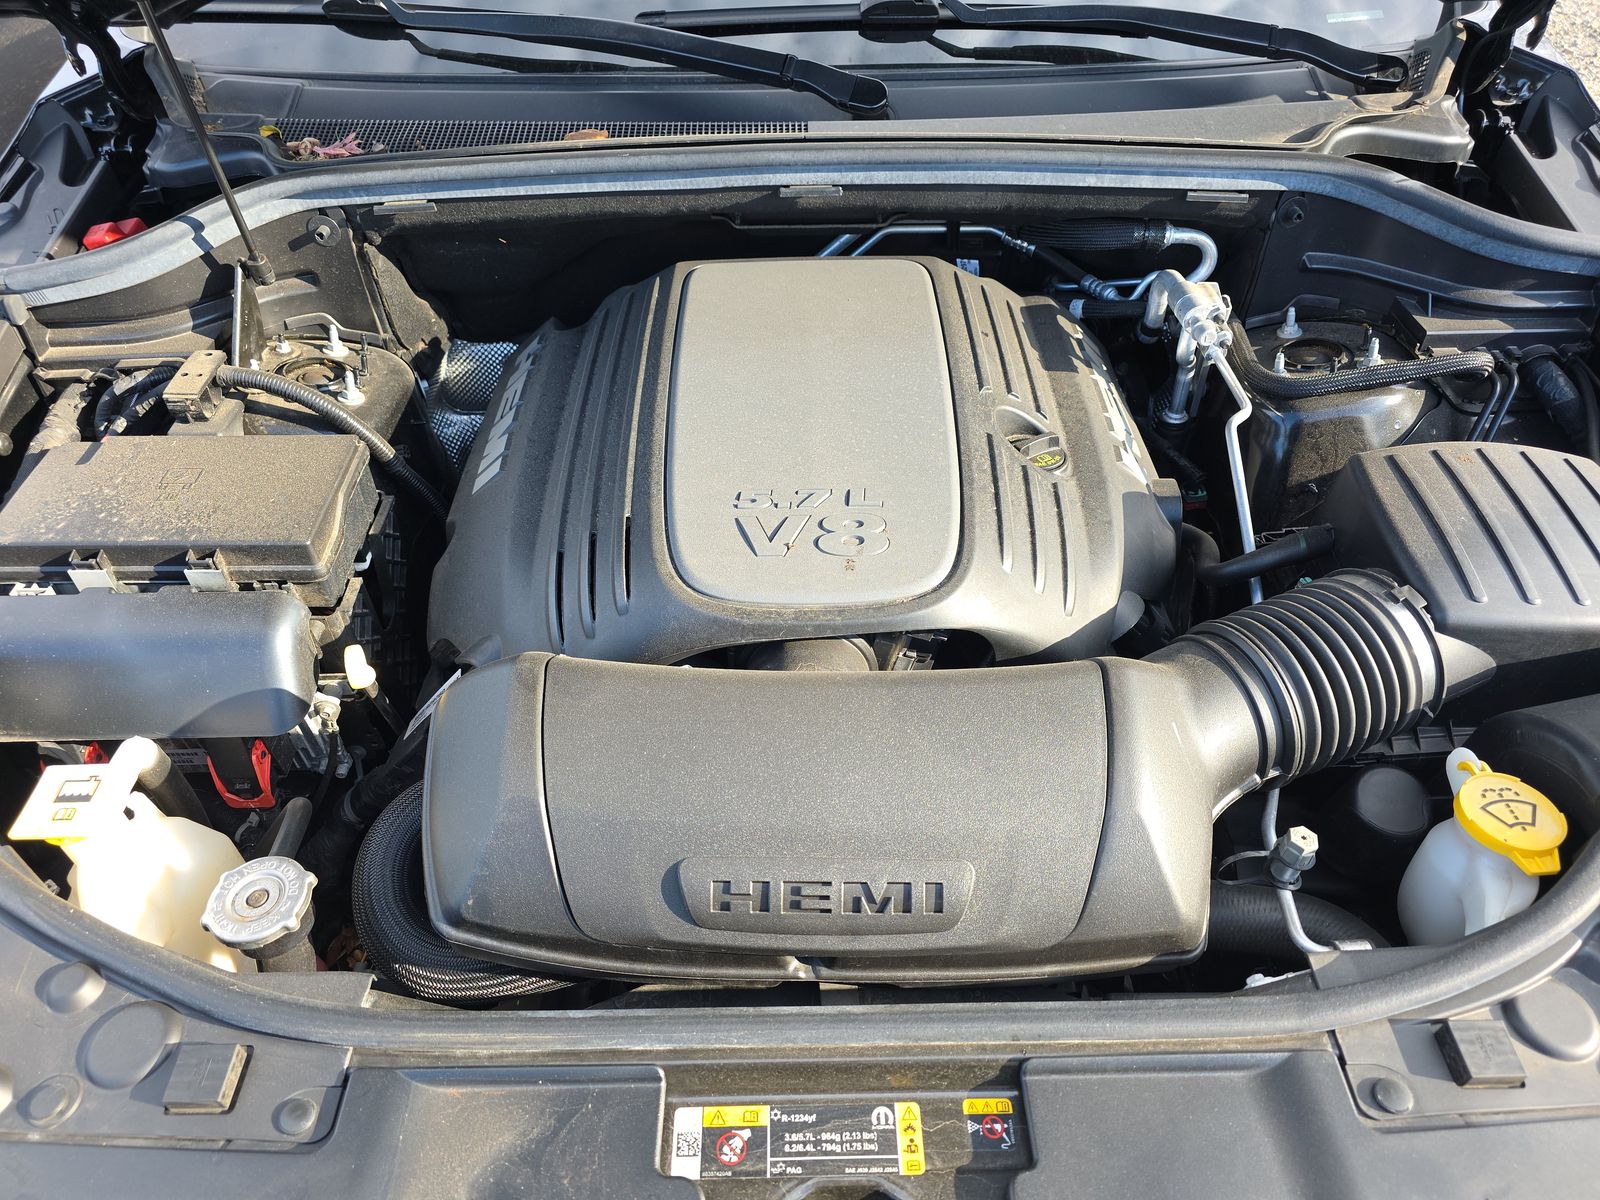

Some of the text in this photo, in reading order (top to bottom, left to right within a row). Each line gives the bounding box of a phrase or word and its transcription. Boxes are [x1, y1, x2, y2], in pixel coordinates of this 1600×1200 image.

[471, 335, 543, 496] HEMI
[733, 512, 891, 558] V8
[710, 879, 944, 914] HEMI
[781, 1113, 817, 1124] R-1234yf
[862, 1131, 878, 1141] lbs)
[863, 1142, 879, 1152] lbs)
[786, 1166, 803, 1174] PAG
